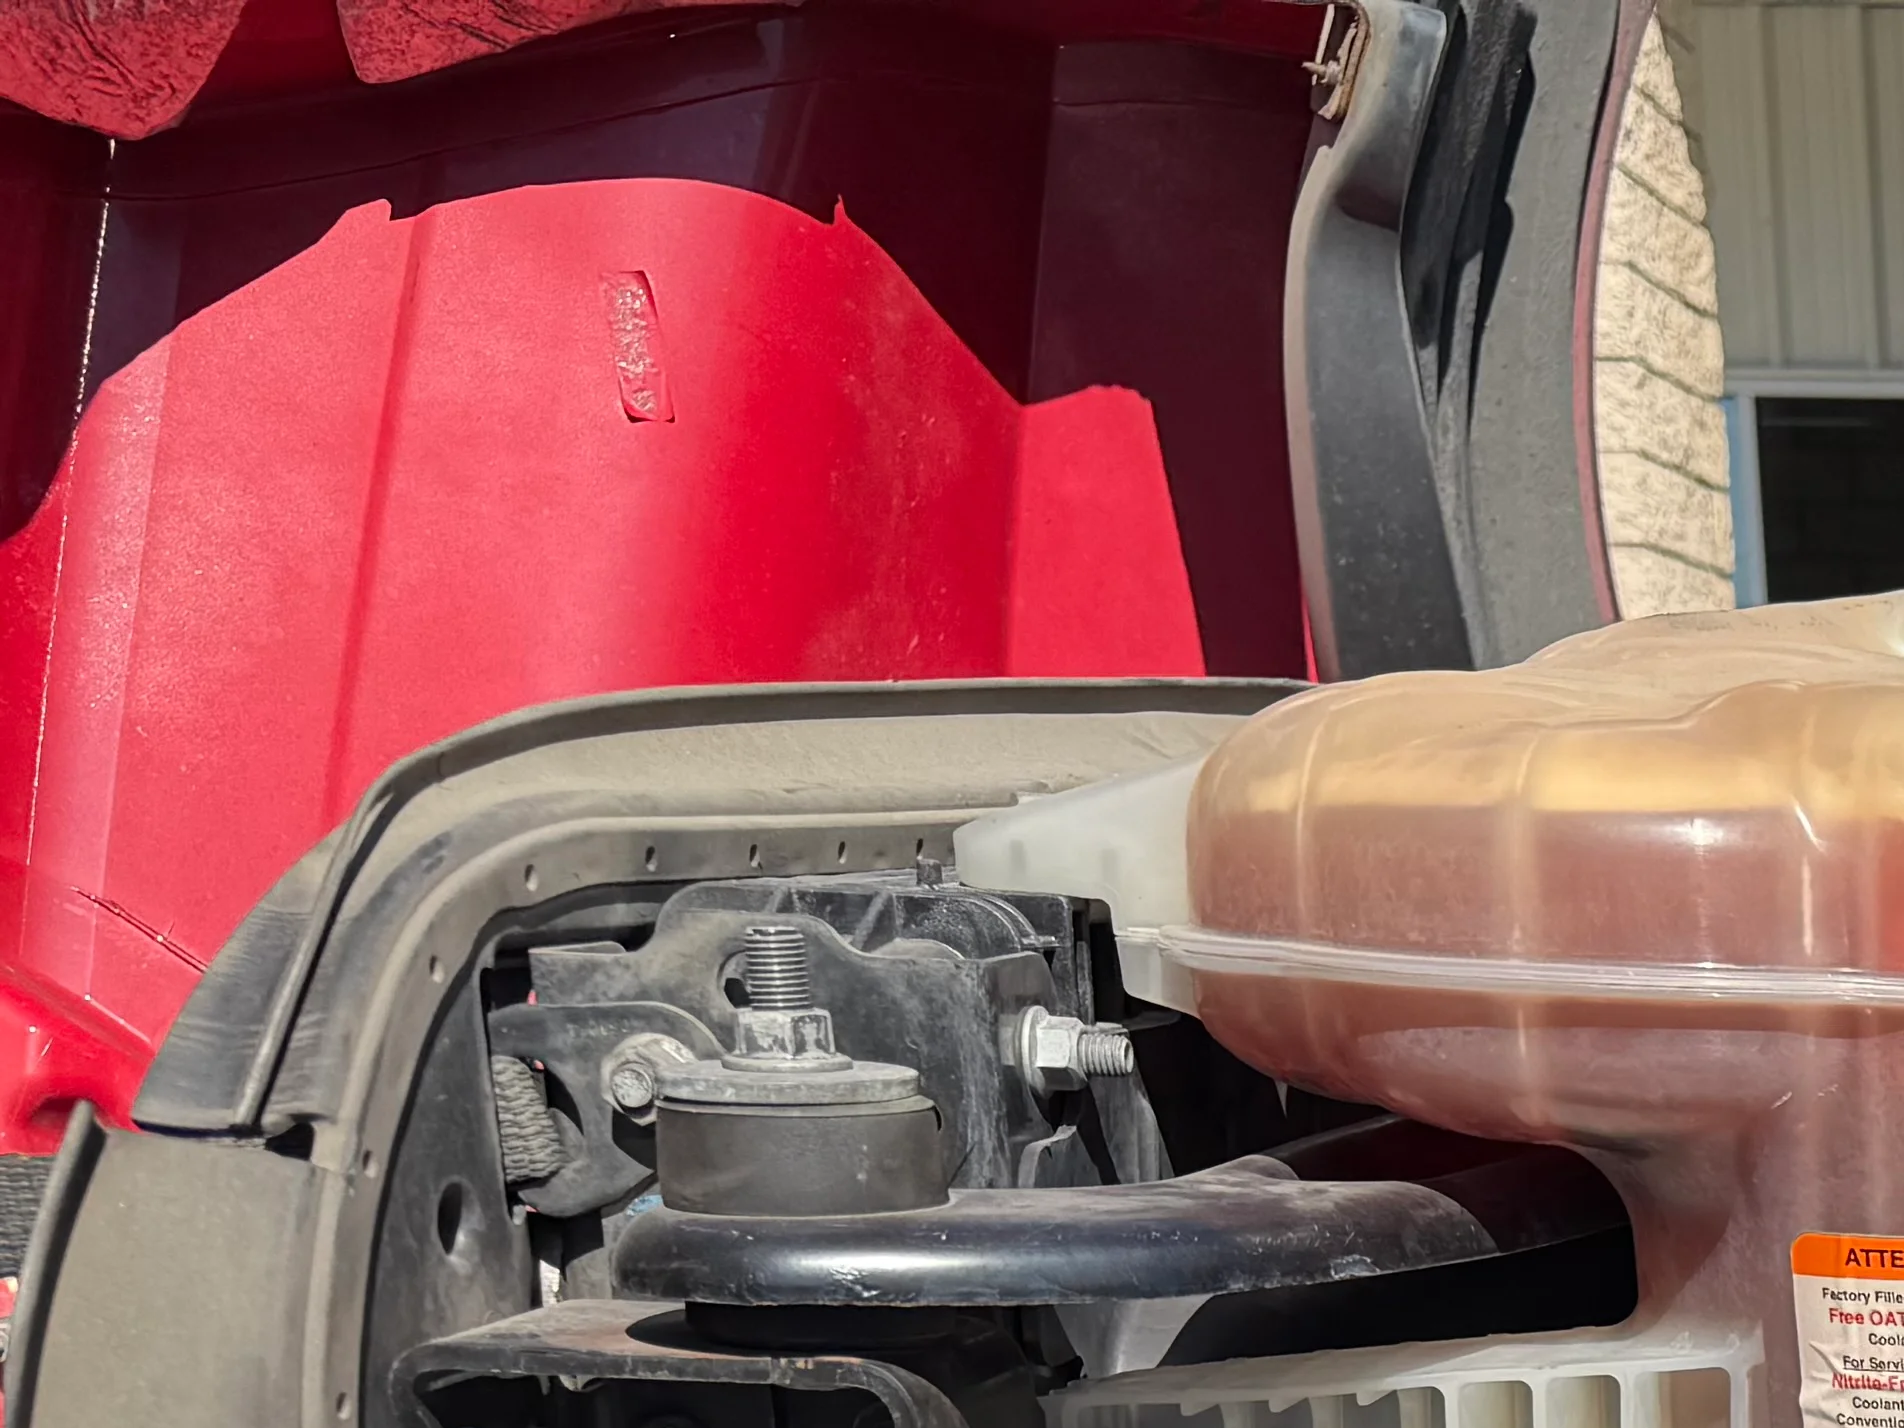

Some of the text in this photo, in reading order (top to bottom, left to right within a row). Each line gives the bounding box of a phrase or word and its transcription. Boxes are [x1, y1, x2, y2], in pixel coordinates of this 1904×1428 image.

[1821, 1287, 1871, 1305] Factory
[1828, 1307, 1865, 1326] Free
[1842, 1355, 1865, 1371] For
